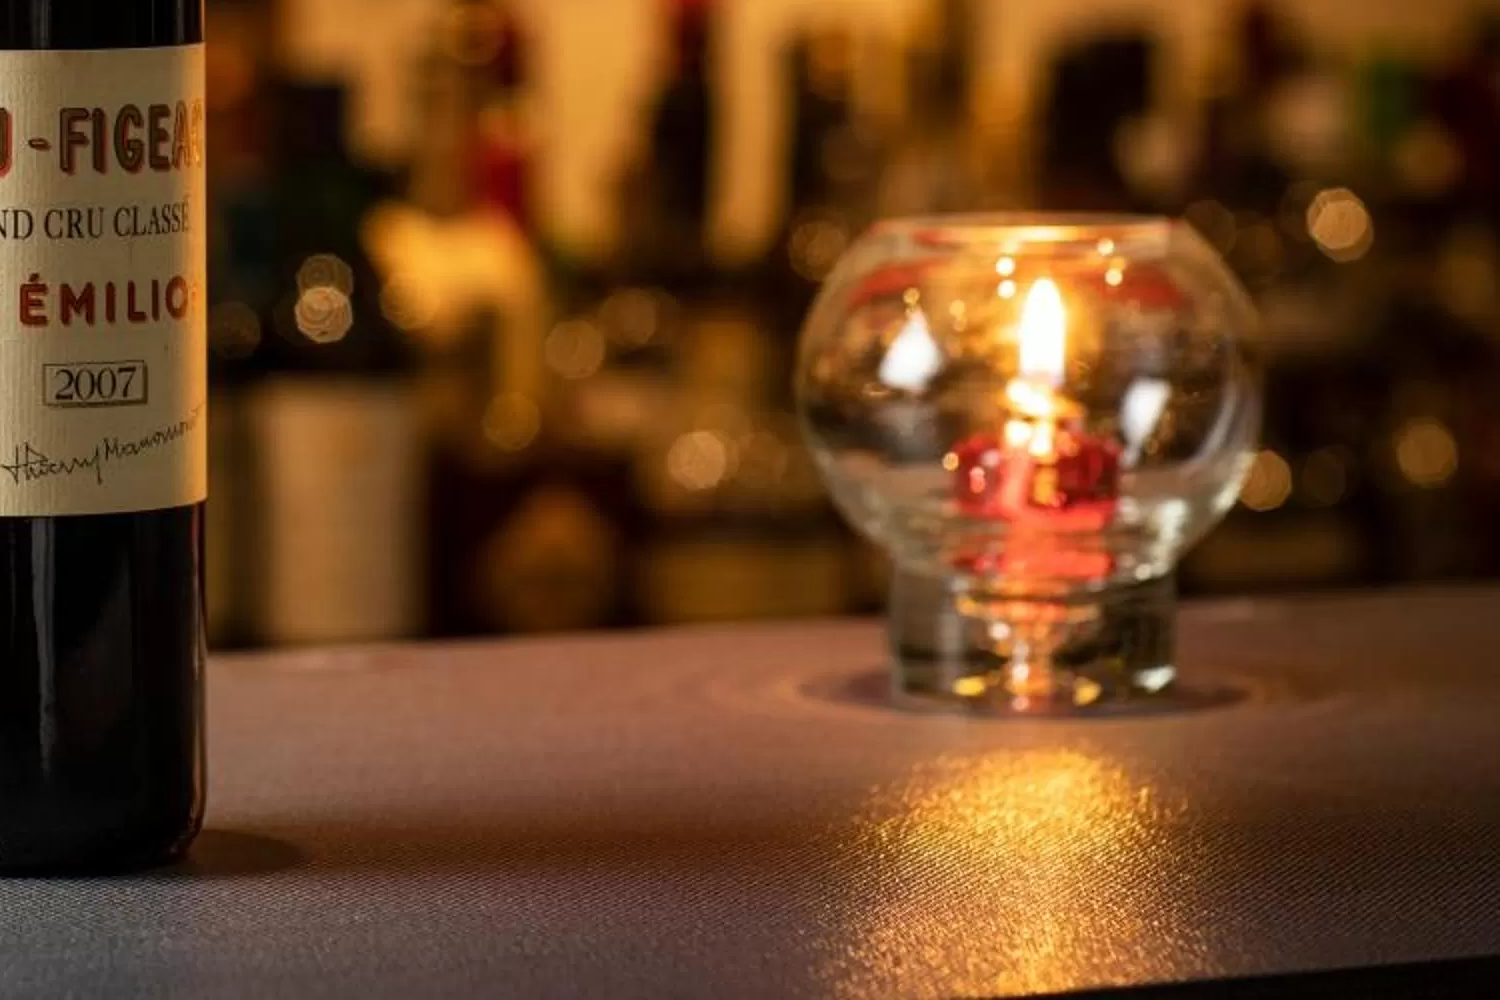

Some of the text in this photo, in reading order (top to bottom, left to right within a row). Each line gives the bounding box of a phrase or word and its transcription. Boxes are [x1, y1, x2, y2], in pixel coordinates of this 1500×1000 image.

[43, 207, 105, 240] CRU
[18, 272, 198, 327] ÉMILIO
[54, 366, 138, 401] 2007
